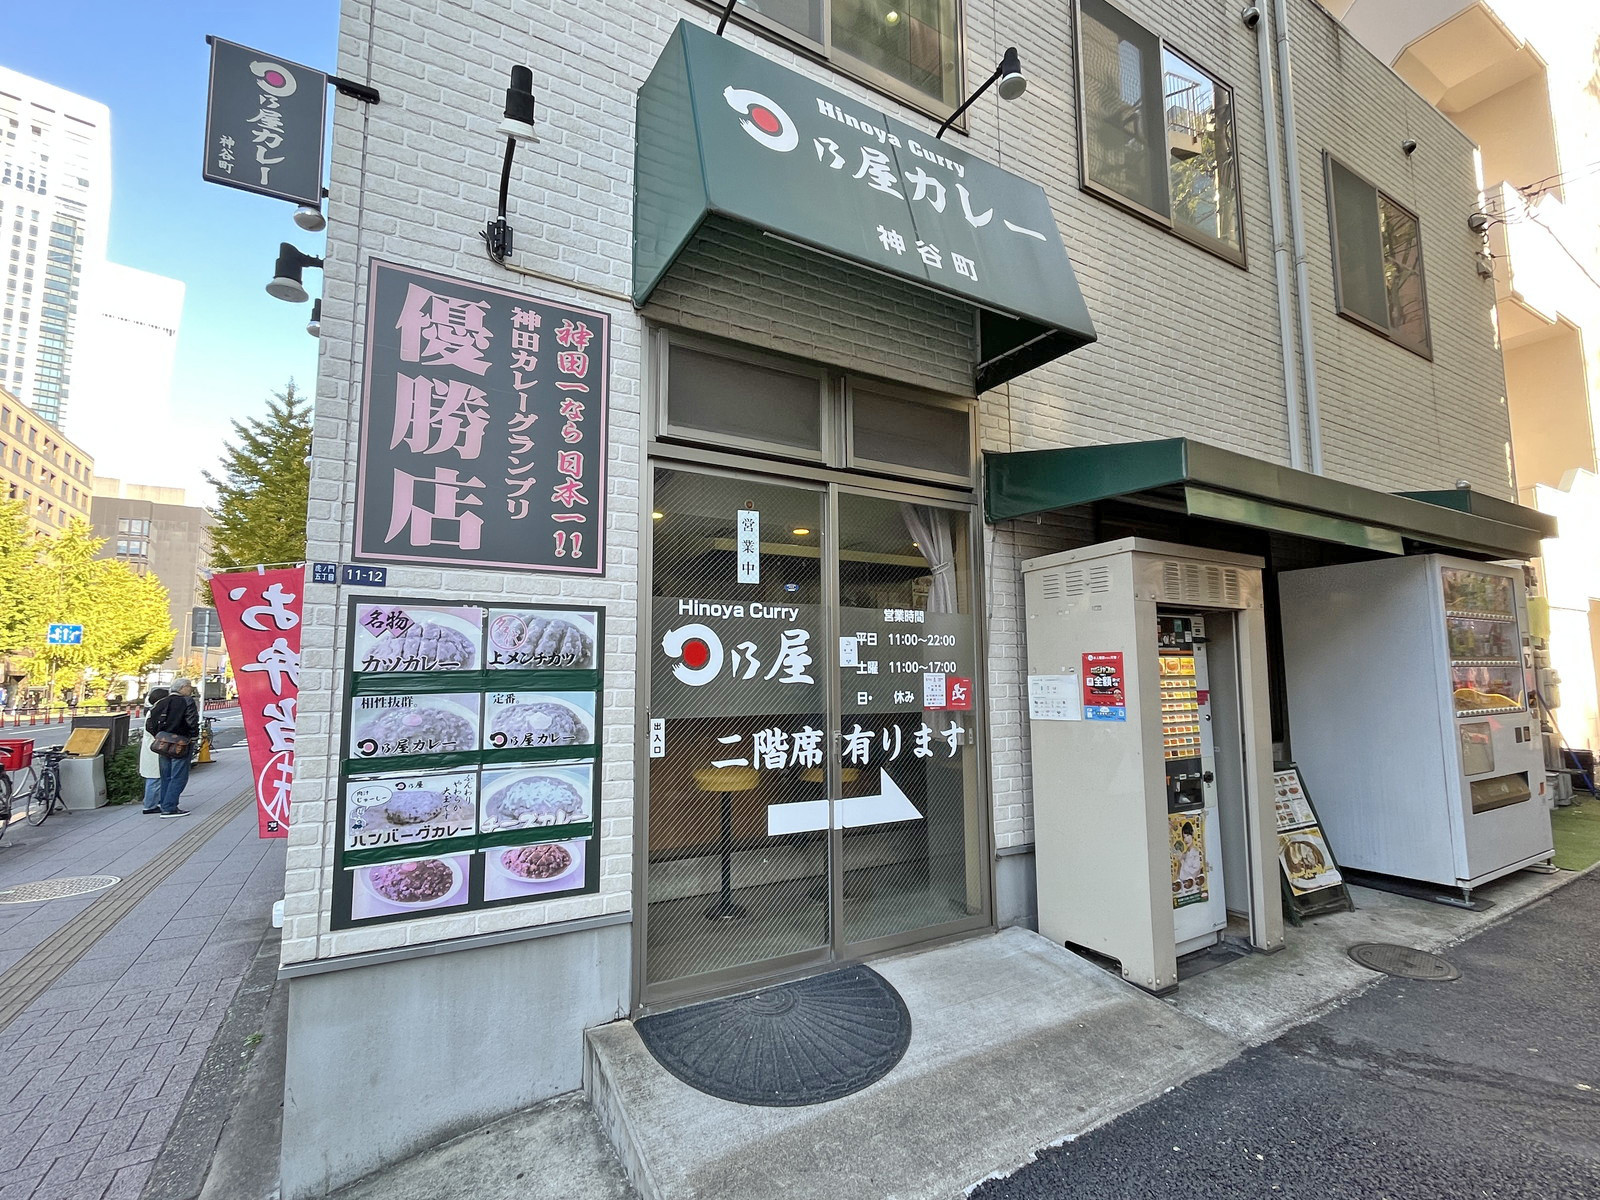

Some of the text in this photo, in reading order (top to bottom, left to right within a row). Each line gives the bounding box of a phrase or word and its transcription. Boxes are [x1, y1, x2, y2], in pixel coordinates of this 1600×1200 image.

[816, 97, 965, 178] Hinoya Curry
[218, 134, 236, 174] 神谷町
[875, 224, 978, 282] 神谷町
[384, 282, 494, 550] 優勝店
[505, 306, 542, 519] 神田カレーグランプリ
[347, 569, 383, 582] 11-12
[364, 609, 412, 631] 名物
[678, 599, 799, 621] Hinoya Curry
[883, 608, 925, 623] 営業時間
[856, 632, 877, 646] 平日
[856, 661, 879, 675] 土曜
[893, 690, 915, 704] 休み
[653, 722, 662, 754] 出入口
[711, 720, 965, 770] 二階席 有ります
[350, 825, 473, 848] ハンバーグカレー
